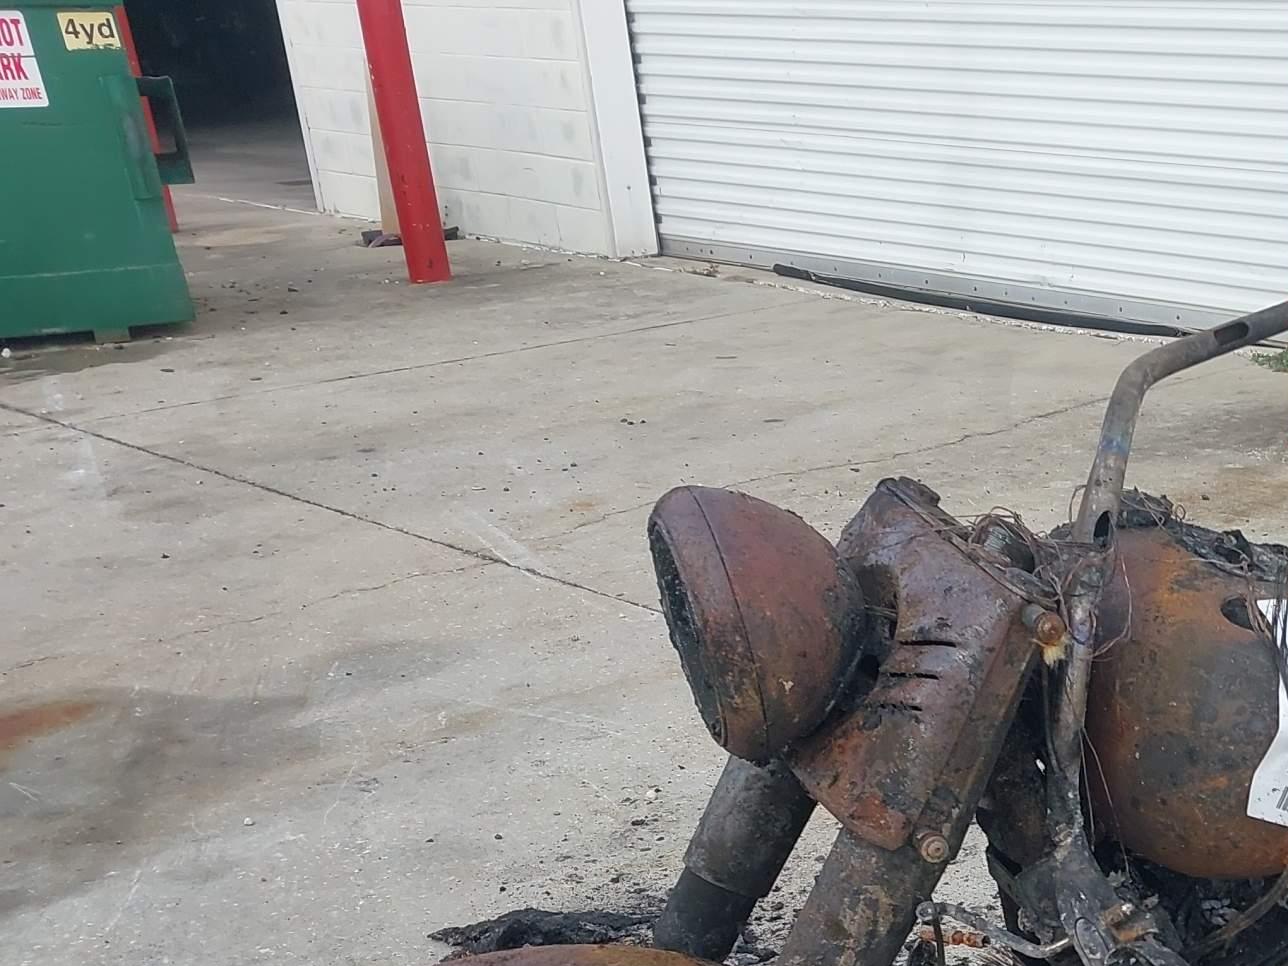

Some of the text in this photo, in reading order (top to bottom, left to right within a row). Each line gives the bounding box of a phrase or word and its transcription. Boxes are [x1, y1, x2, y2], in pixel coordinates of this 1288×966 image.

[0, 18, 24, 46] OT
[64, 18, 115, 44] 4yd
[20, 87, 43, 100] ZONE
